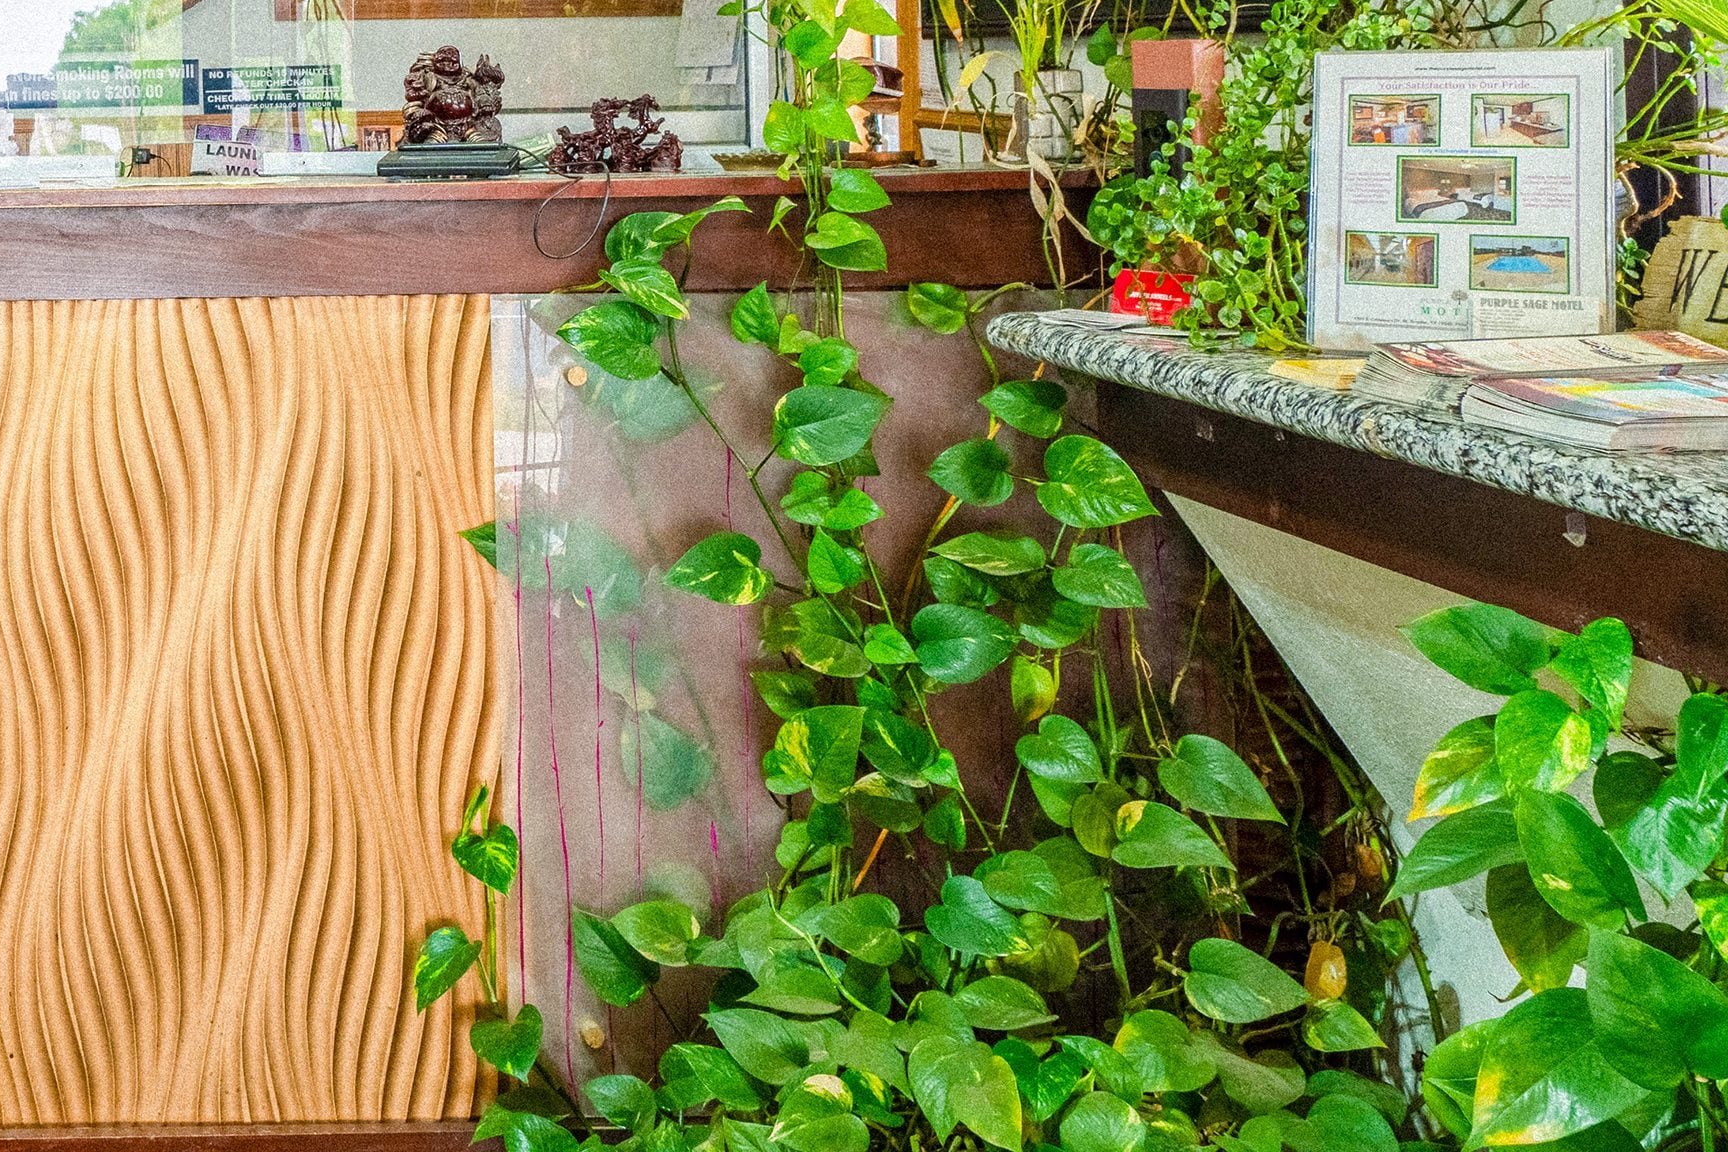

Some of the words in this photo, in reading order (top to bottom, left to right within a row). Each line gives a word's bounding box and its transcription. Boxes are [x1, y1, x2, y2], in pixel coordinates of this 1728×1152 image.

[114, 64, 165, 81] Rooms
[167, 63, 195, 79] will
[209, 71, 224, 80] NO
[290, 67, 335, 78] MINUTES
[1379, 81, 1403, 90] Your
[1405, 80, 1465, 89] Satisfaction
[1479, 80, 1498, 88] Our
[21, 86, 57, 102] fines
[62, 88, 81, 103] up
[86, 86, 101, 100] to
[105, 83, 163, 101] $200.00
[268, 92, 292, 101] TIME
[313, 100, 332, 108] HOUR
[206, 143, 257, 160] LAUN
[1480, 297, 1520, 309] PURPLE
[1522, 298, 1549, 310] SAGE
[1551, 300, 1585, 311] MOTEL
